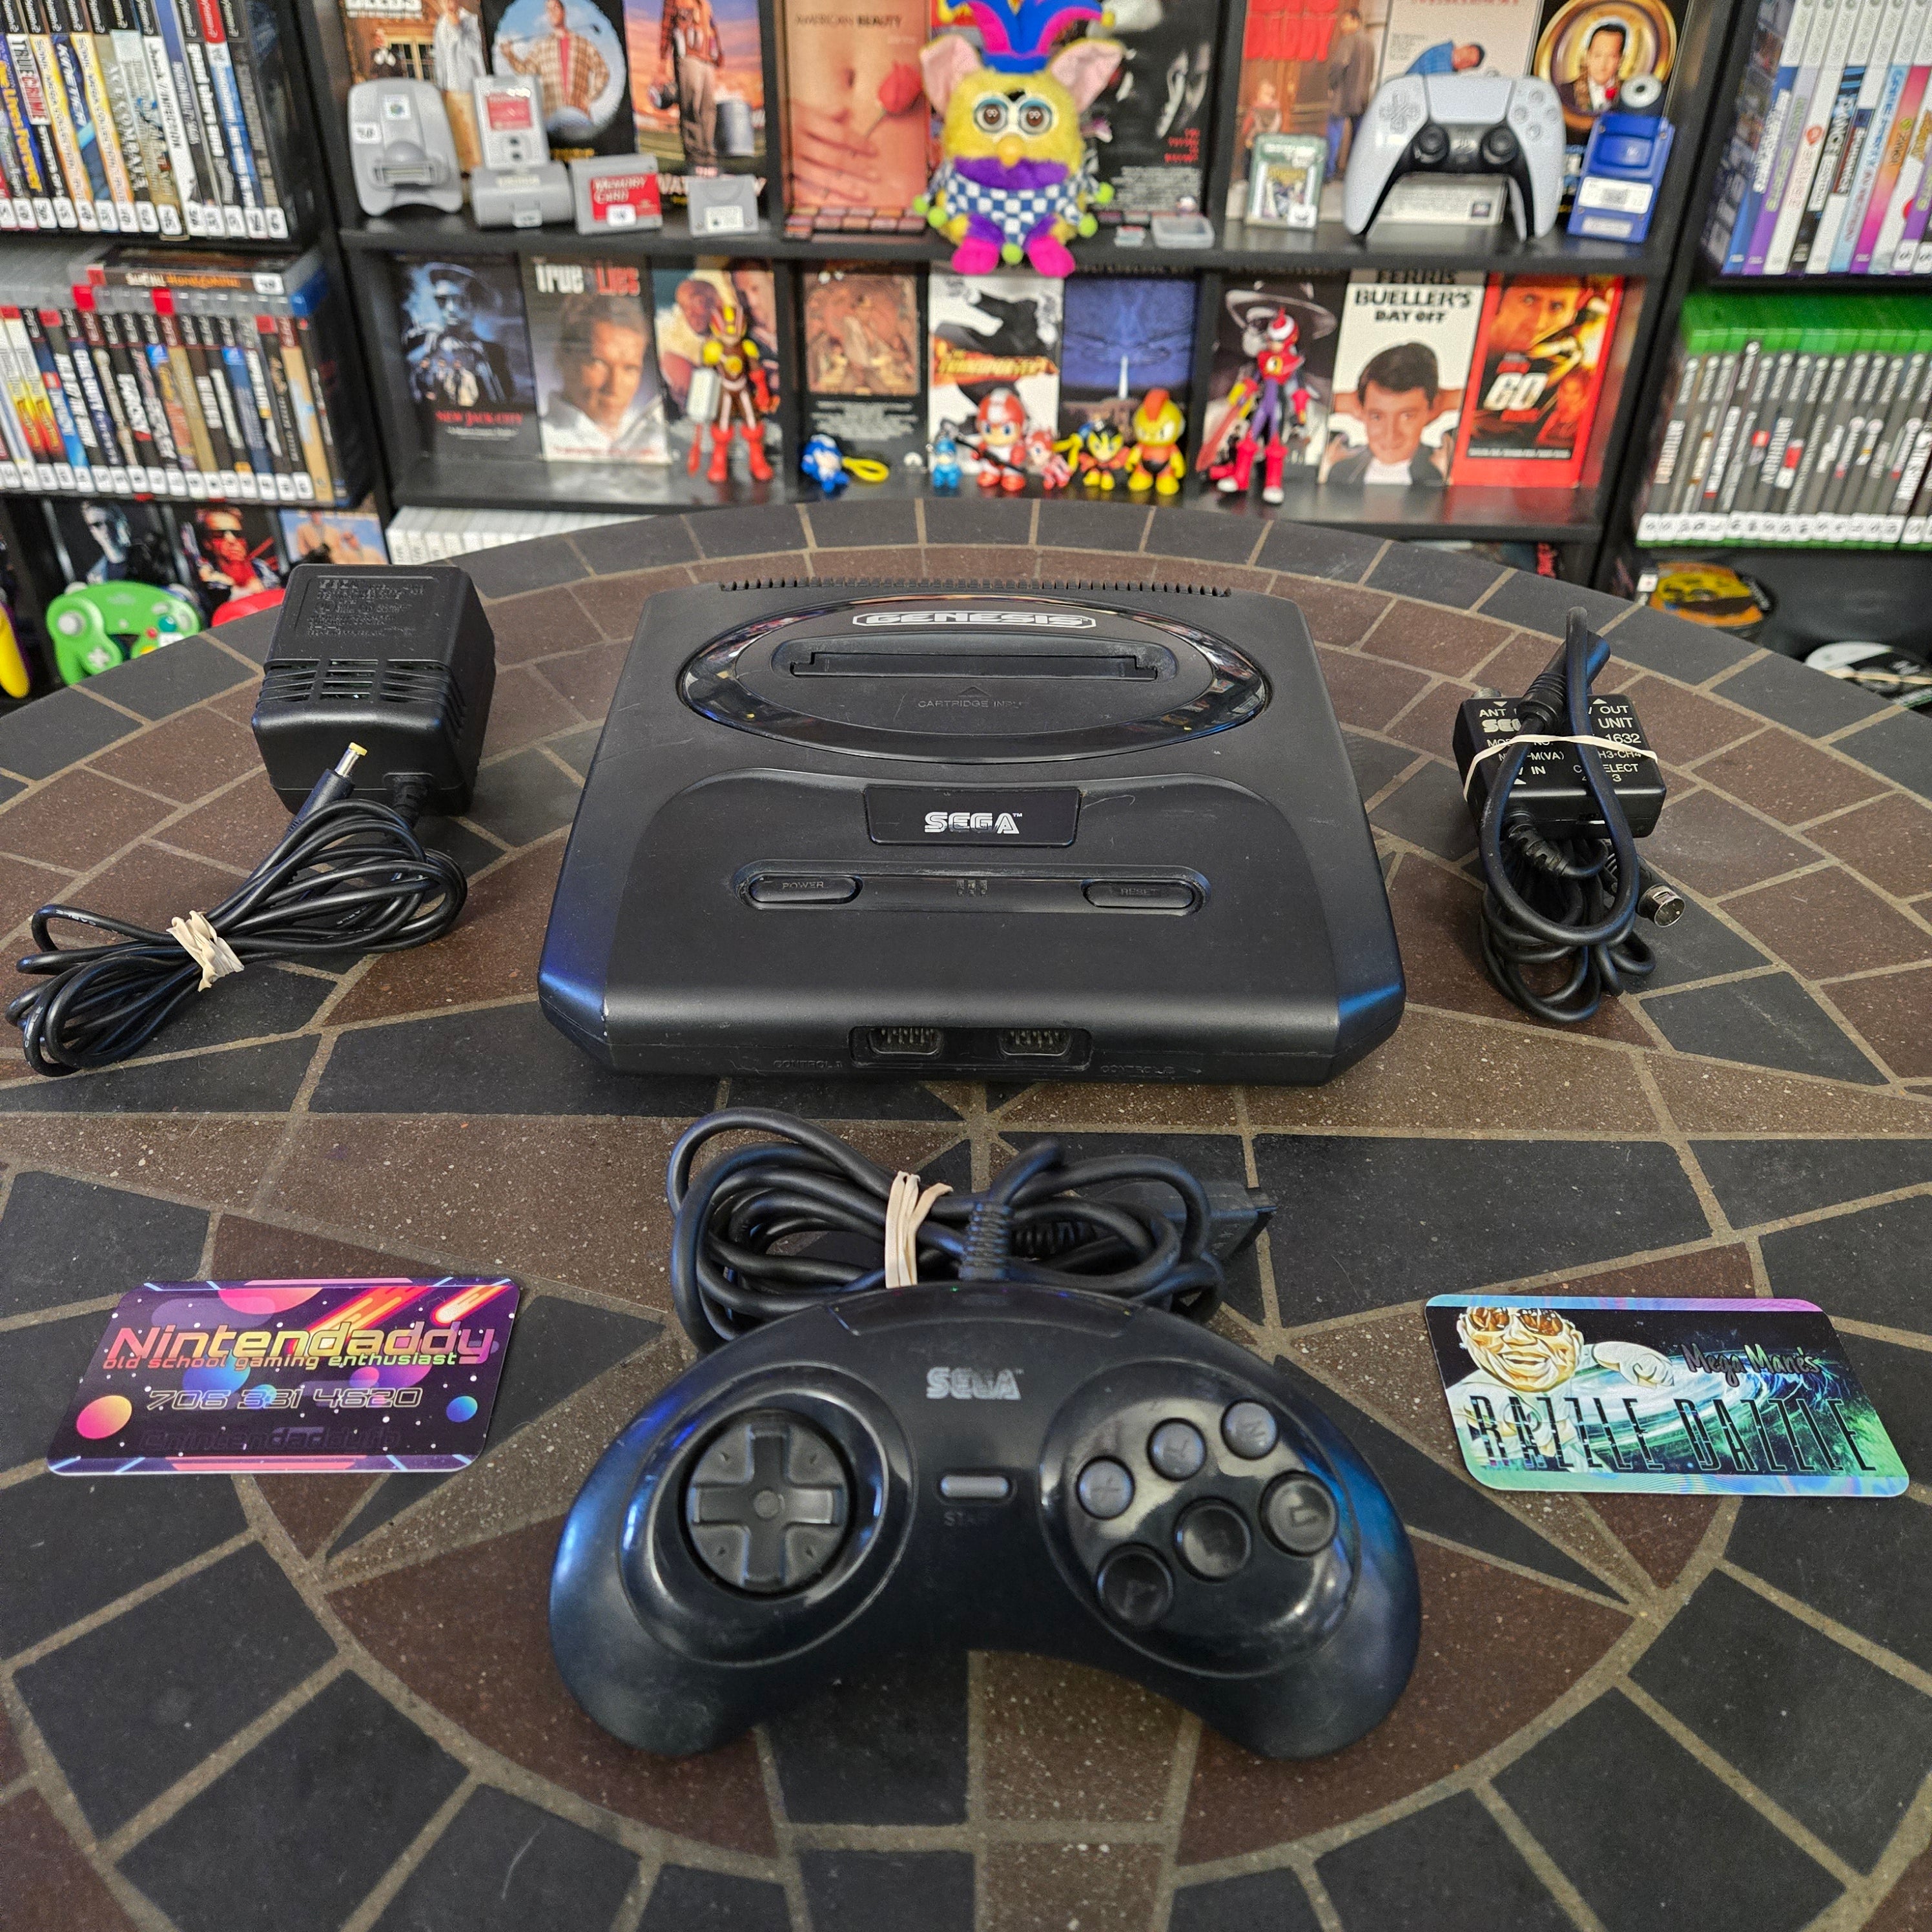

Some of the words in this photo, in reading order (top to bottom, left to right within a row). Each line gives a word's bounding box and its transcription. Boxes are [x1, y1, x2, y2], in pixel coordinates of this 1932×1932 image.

[1355, 290, 1470, 307] BUELLER'S
[1376, 311, 1410, 322] DAY
[1415, 311, 1445, 323] OFF
[865, 613, 1085, 625] GENESIS
[1479, 708, 1506, 717] ANT
[1599, 706, 1629, 714] OUT
[1598, 717, 1633, 728] UNIT
[1531, 766, 1546, 775] IN
[1603, 763, 1638, 773] ELECT
[924, 812, 1020, 834] SEGA
[782, 881, 824, 889] POWER
[106, 1321, 495, 1364] Nintendaddy
[103, 1356, 138, 1370] old
[147, 1355, 227, 1370] school
[234, 1354, 320, 1372] gaming
[327, 1351, 458, 1368] enthusiast
[1680, 1343, 1747, 1388] Mega
[146, 1390, 231, 1411] 706
[237, 1388, 303, 1410] 331
[313, 1387, 424, 1409] 4620
[1469, 1395, 1664, 1470] RAZZLE
[1678, 1397, 1877, 1472] DAZZLE
